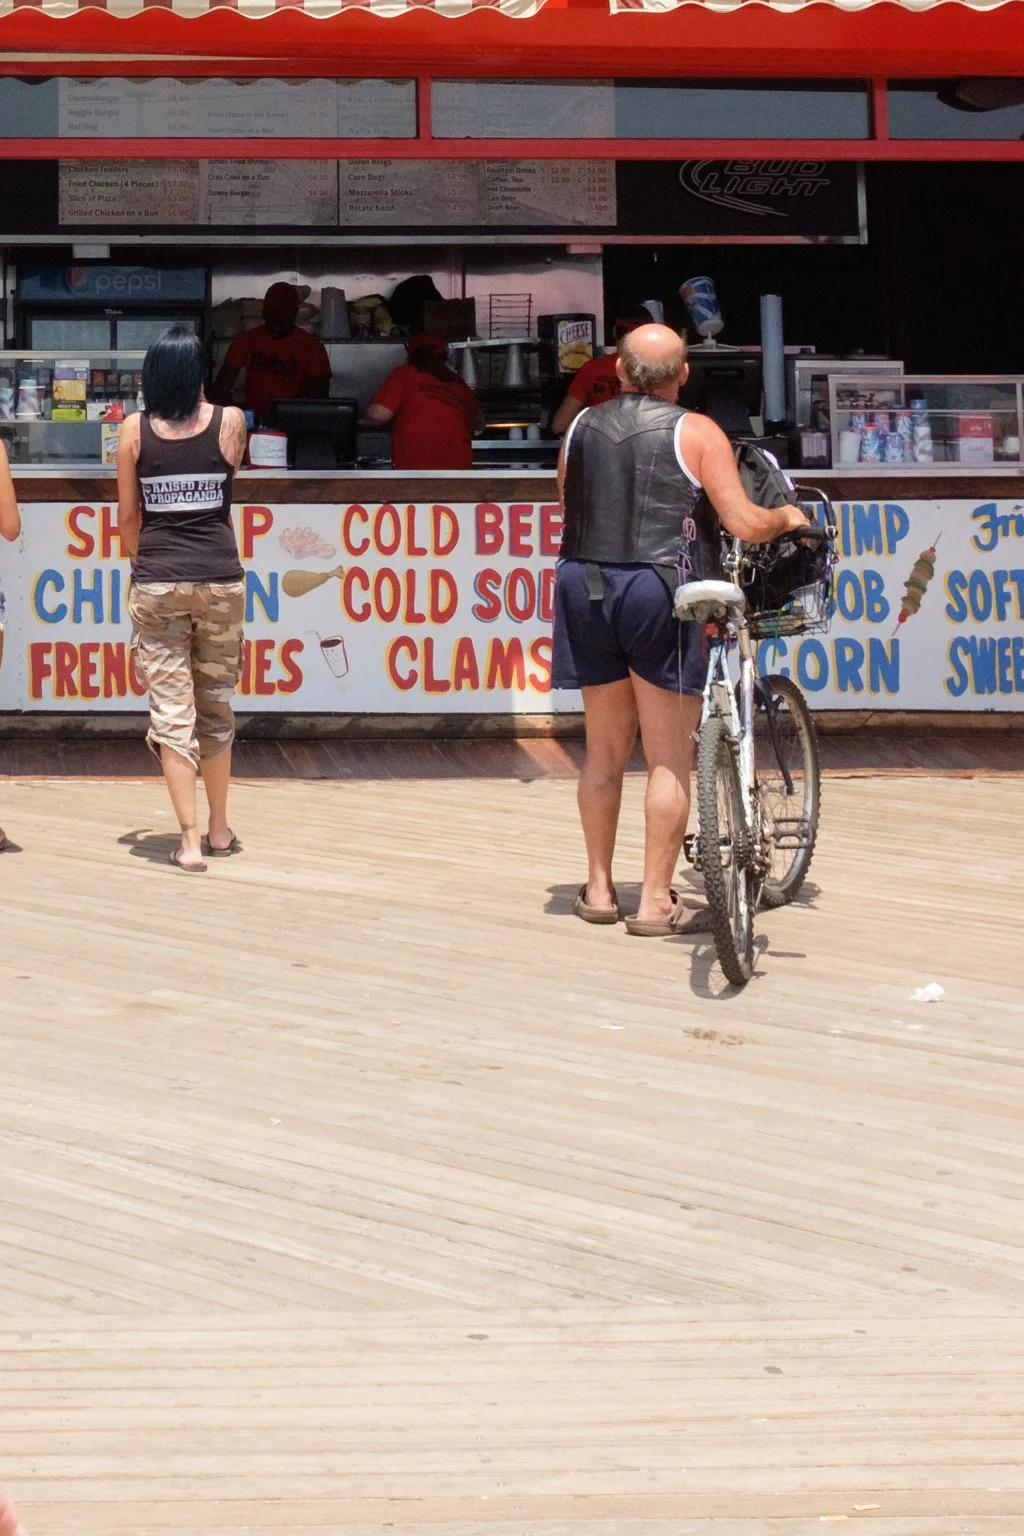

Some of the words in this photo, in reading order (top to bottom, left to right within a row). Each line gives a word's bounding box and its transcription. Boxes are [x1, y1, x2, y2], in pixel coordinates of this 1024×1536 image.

[724, 159, 826, 176] BUD
[68, 180, 86, 189] Fried
[88, 180, 119, 189] Chicken
[699, 172, 832, 196] LIGHT
[208, 190, 228, 198] Turkey
[348, 189, 388, 197] Mozzarella
[390, 189, 413, 197] Sticks
[68, 209, 93, 217] Grilled
[94, 209, 124, 217] Chicken
[126, 209, 136, 217] on
[144, 209, 159, 217] Bun
[349, 204, 373, 212] Potato
[97, 270, 162, 295] pepsi
[560, 323, 590, 345] CHEESE
[153, 481, 195, 493] RAISED
[198, 480, 222, 491] FIST
[150, 489, 223, 504] PROPAGANDA
[341, 504, 460, 557] COLD
[475, 503, 564, 557] BEE
[32, 568, 279, 624] CHIN
[341, 566, 459, 624] COLD
[386, 635, 553, 695] CLAMS
